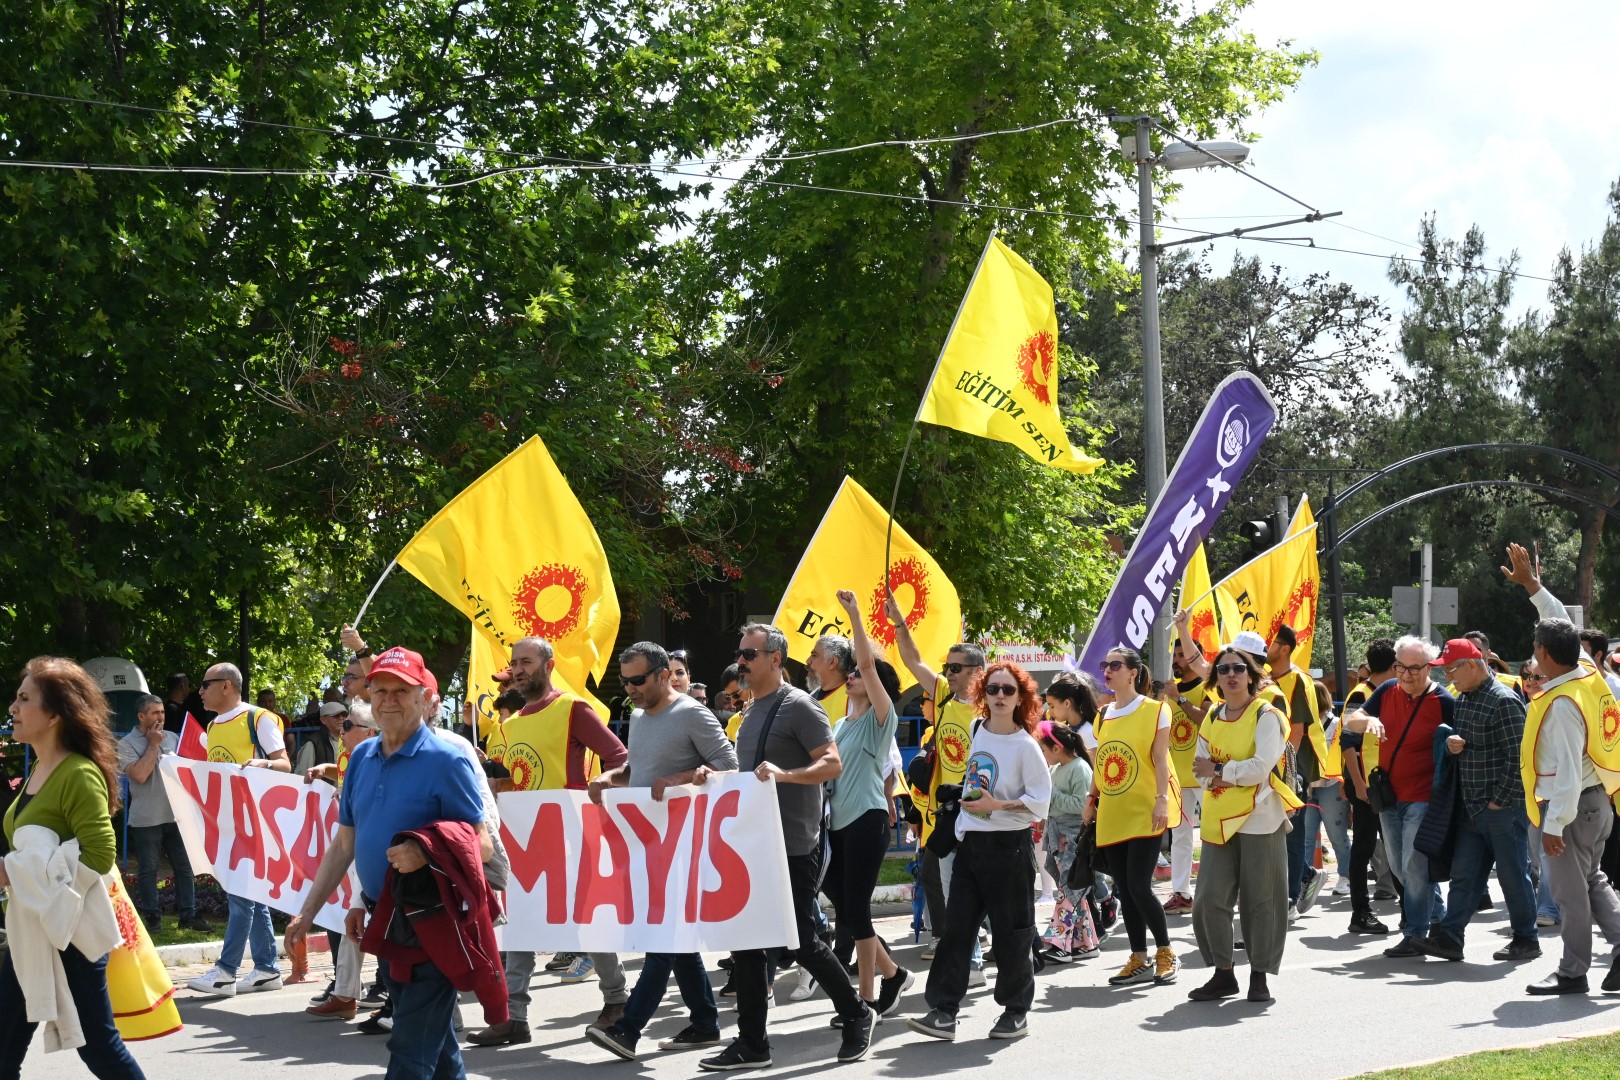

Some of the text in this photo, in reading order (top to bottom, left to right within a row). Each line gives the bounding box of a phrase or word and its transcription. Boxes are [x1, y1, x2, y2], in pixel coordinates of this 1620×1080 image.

[955, 368, 1064, 462] EĞİTİM SEN
[525, 753, 540, 769] SEN
[500, 790, 751, 925] MAYIS
